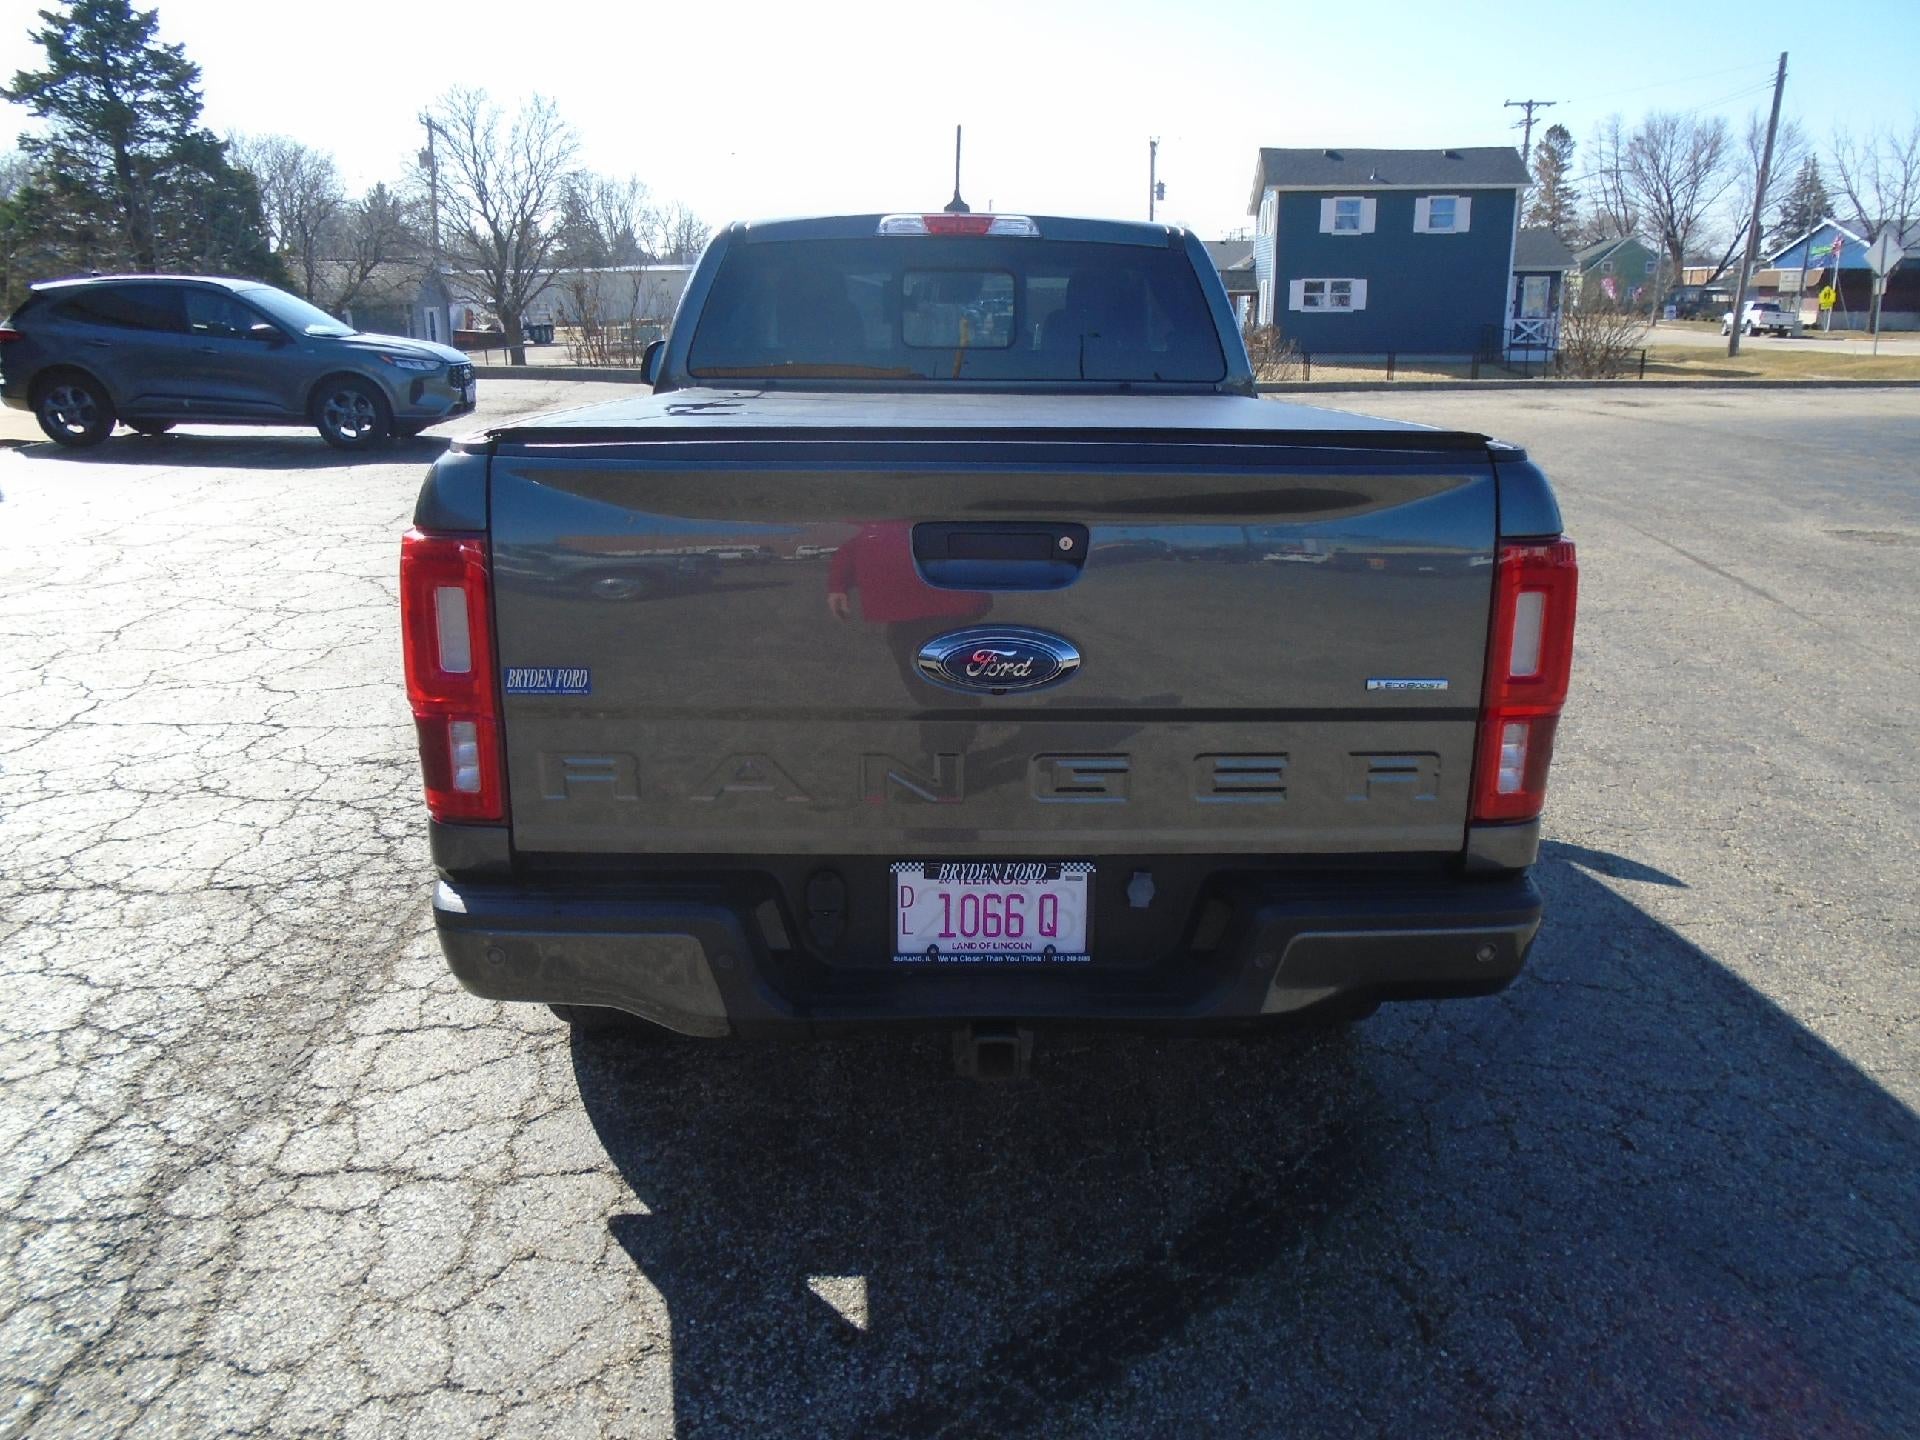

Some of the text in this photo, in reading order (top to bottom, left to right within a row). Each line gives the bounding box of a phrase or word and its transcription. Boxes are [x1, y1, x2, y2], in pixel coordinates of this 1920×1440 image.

[965, 649, 1034, 677] Ford
[507, 668, 588, 688] BRYDEN FORD
[538, 751, 1441, 803] RANGER
[938, 863, 1047, 879] BRYDEN FORD
[938, 893, 1058, 938] 1066 Q
[951, 942, 1032, 950] LAND OF LINCOLN
[985, 954, 1003, 962] Than
[1005, 954, 1019, 962] You
